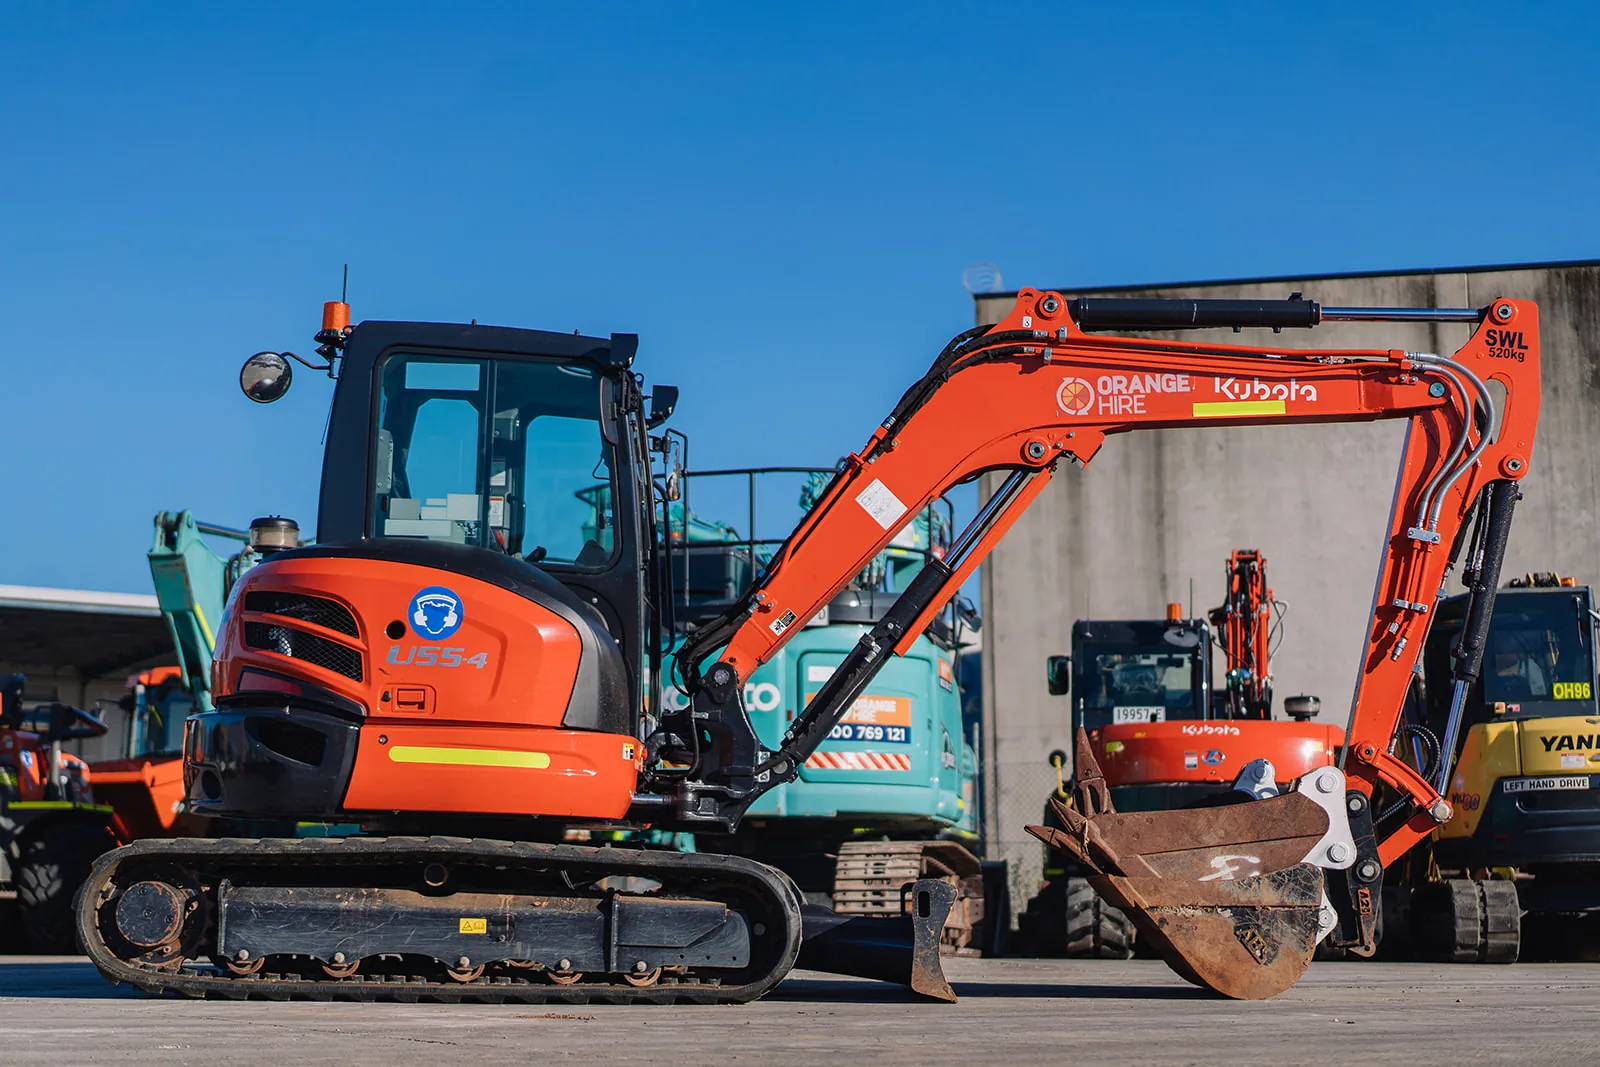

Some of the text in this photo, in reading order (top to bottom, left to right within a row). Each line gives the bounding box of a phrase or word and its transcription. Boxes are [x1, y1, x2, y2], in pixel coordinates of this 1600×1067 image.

[1485, 329, 1529, 350] SWL
[1489, 347, 1525, 363] 520kg
[1097, 373, 1192, 394] ORANGE
[1214, 377, 1317, 402] Kubota
[1097, 394, 1147, 415] HIRE
[386, 645, 488, 669] U55-4
[1553, 683, 1591, 699] OH96
[1117, 708, 1150, 721] 19957
[857, 726, 884, 740] 769
[886, 728, 906, 742] 121
[1182, 724, 1240, 736] Kubota
[1505, 778, 1588, 791] LEFT HAND DRIVE
